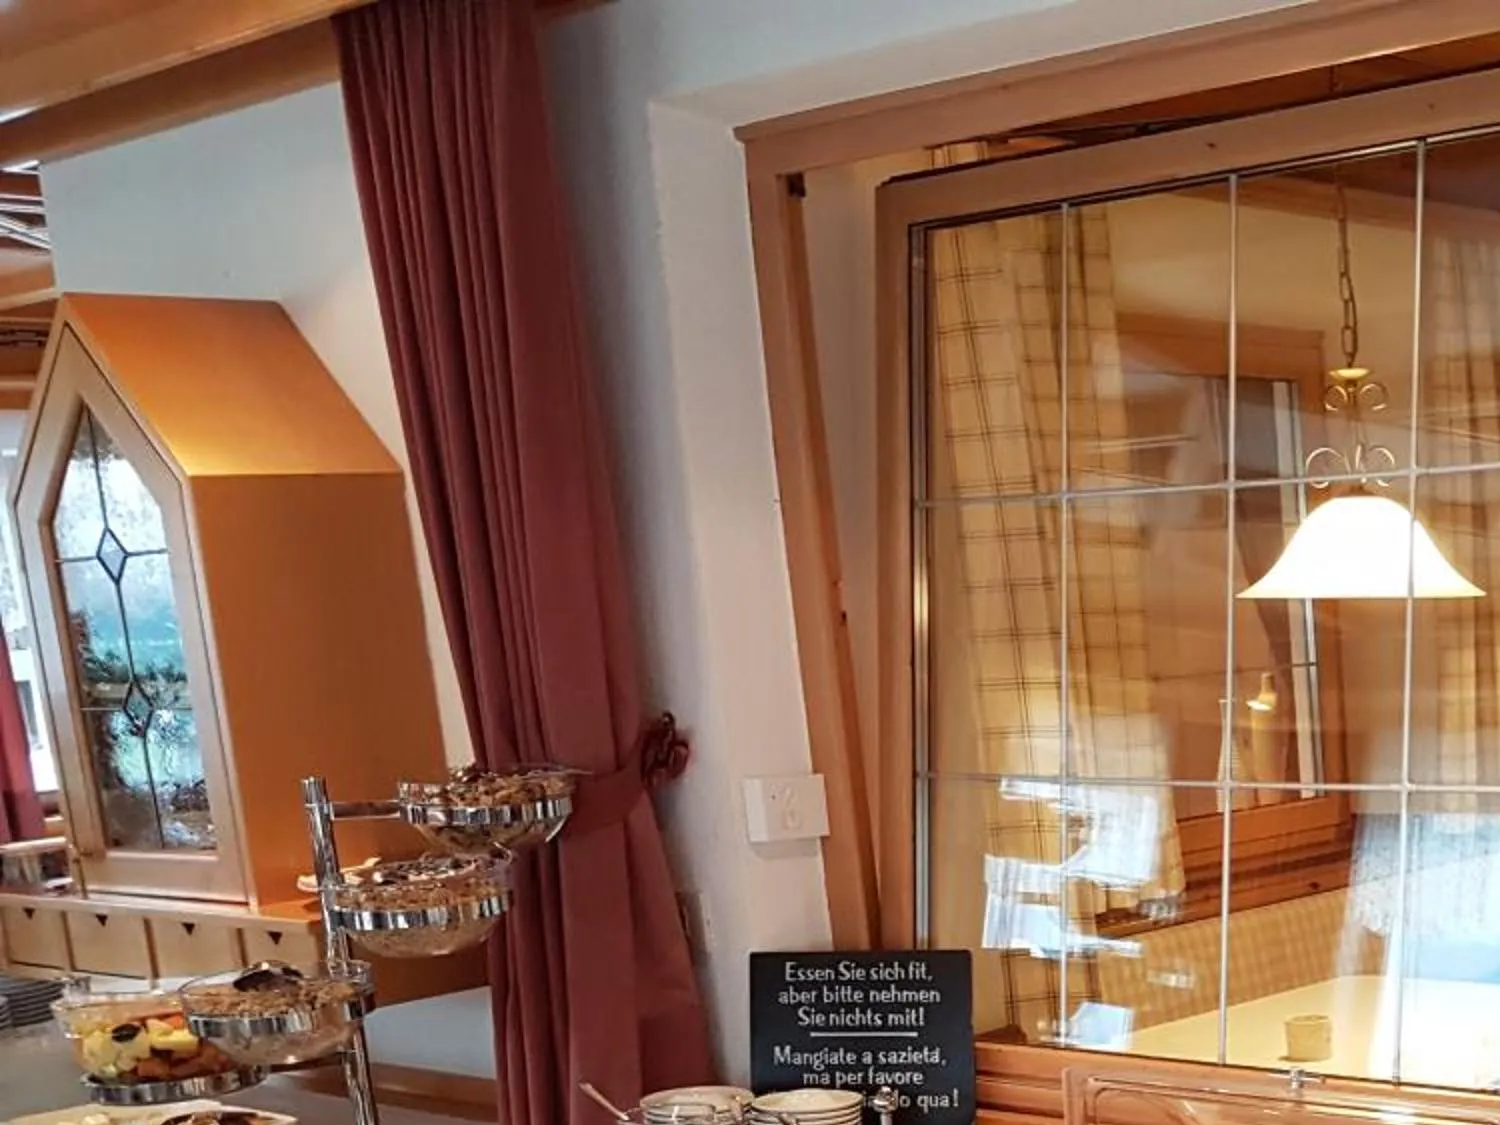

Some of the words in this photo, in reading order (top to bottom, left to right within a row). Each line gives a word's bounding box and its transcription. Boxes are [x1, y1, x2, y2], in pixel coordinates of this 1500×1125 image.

[786, 961, 835, 982] Essen
[838, 960, 865, 981] Sie
[870, 961, 905, 981] sich
[908, 961, 933, 982] fit,
[778, 985, 816, 1004] aber
[823, 985, 864, 1003] bitte
[869, 984, 941, 1003] nehmen
[798, 1006, 826, 1026] Sie
[829, 1007, 883, 1026] nichts
[887, 1007, 925, 1026] mit!
[773, 1046, 857, 1070] Mangiate
[861, 1051, 872, 1065] a
[803, 1071, 830, 1085] ma
[835, 1071, 863, 1088] per
[868, 1066, 923, 1085] favore
